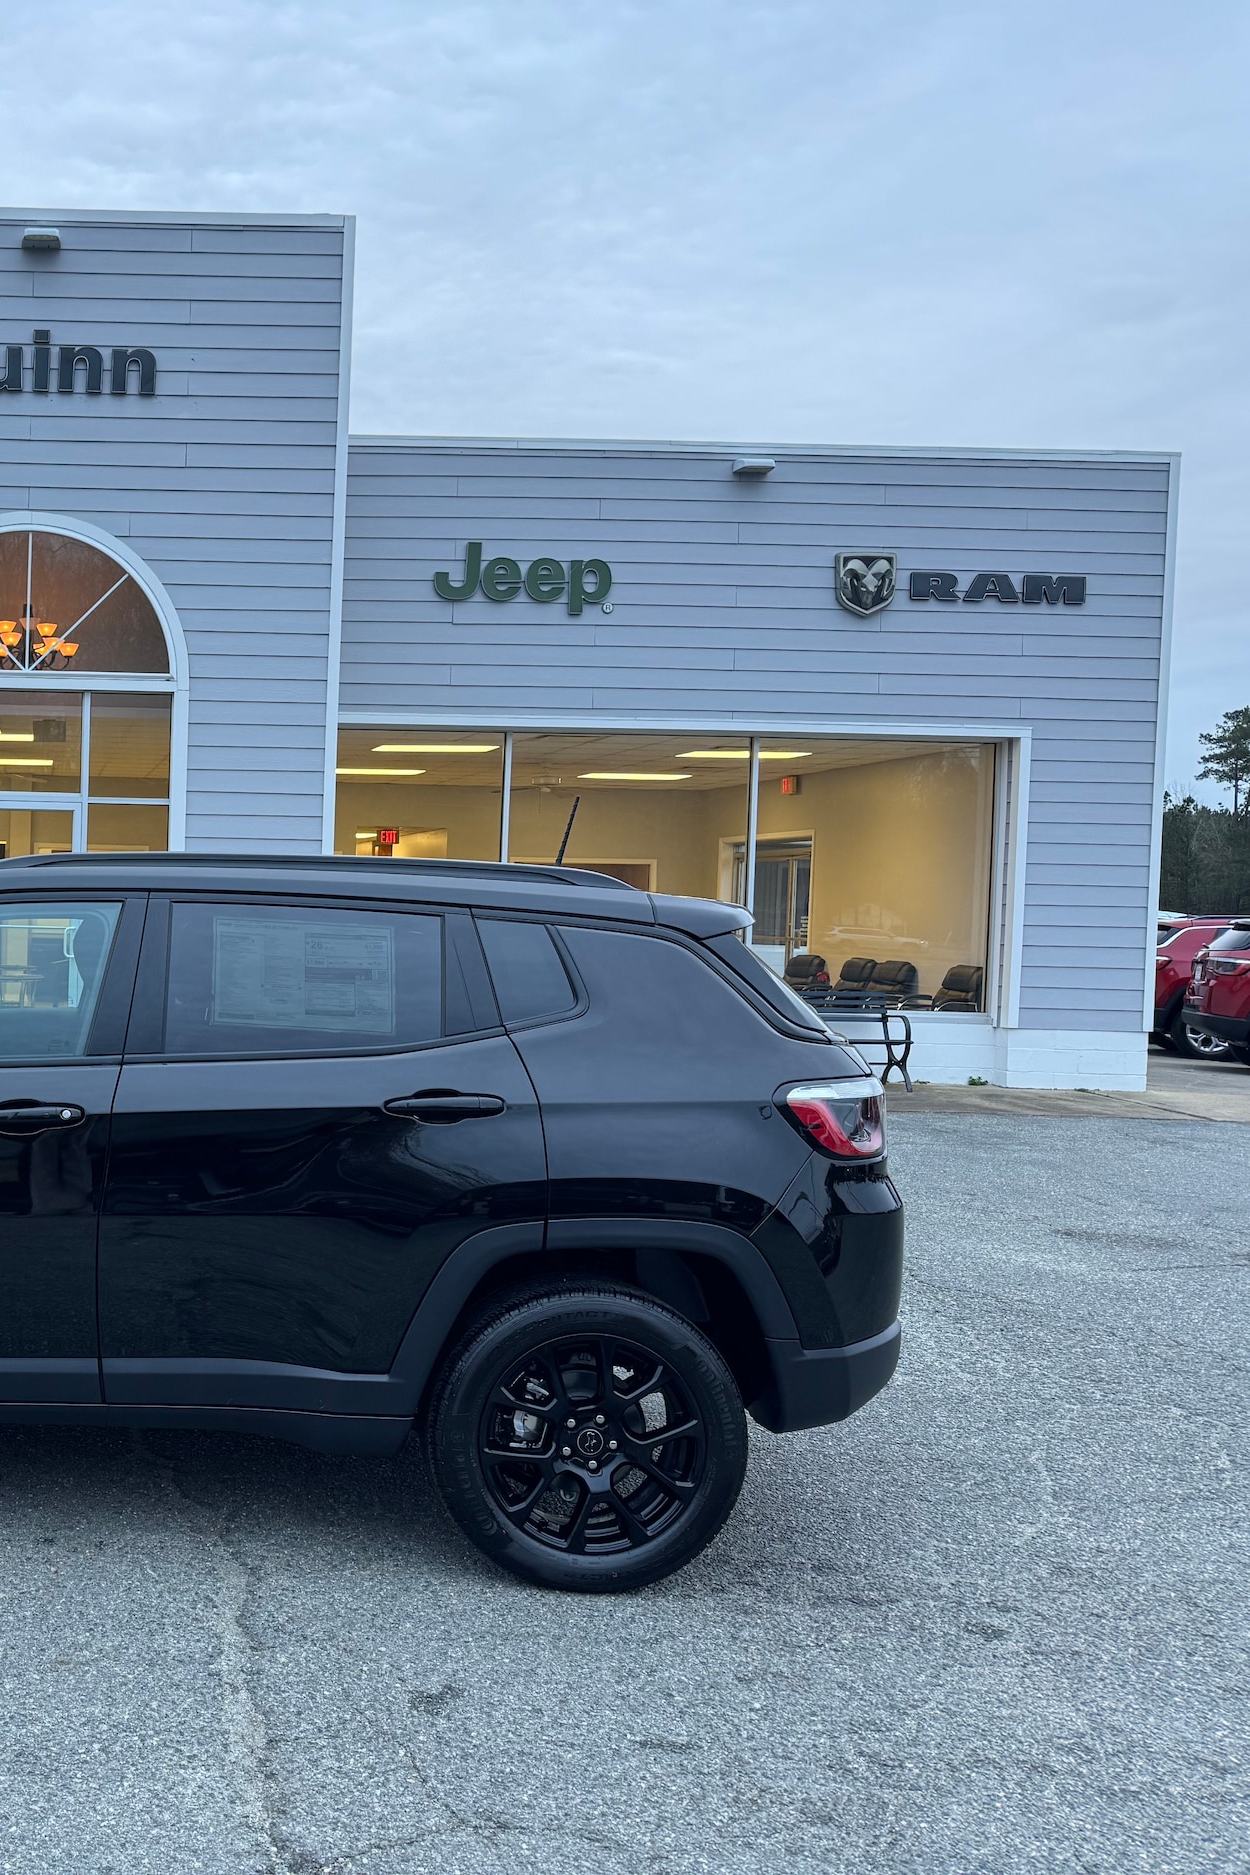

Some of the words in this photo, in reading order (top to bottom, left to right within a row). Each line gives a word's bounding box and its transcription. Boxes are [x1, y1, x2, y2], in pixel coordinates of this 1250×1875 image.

[434, 541, 612, 615] Jeep
[910, 571, 1087, 604] RAM
[380, 830, 397, 843] EXIT
